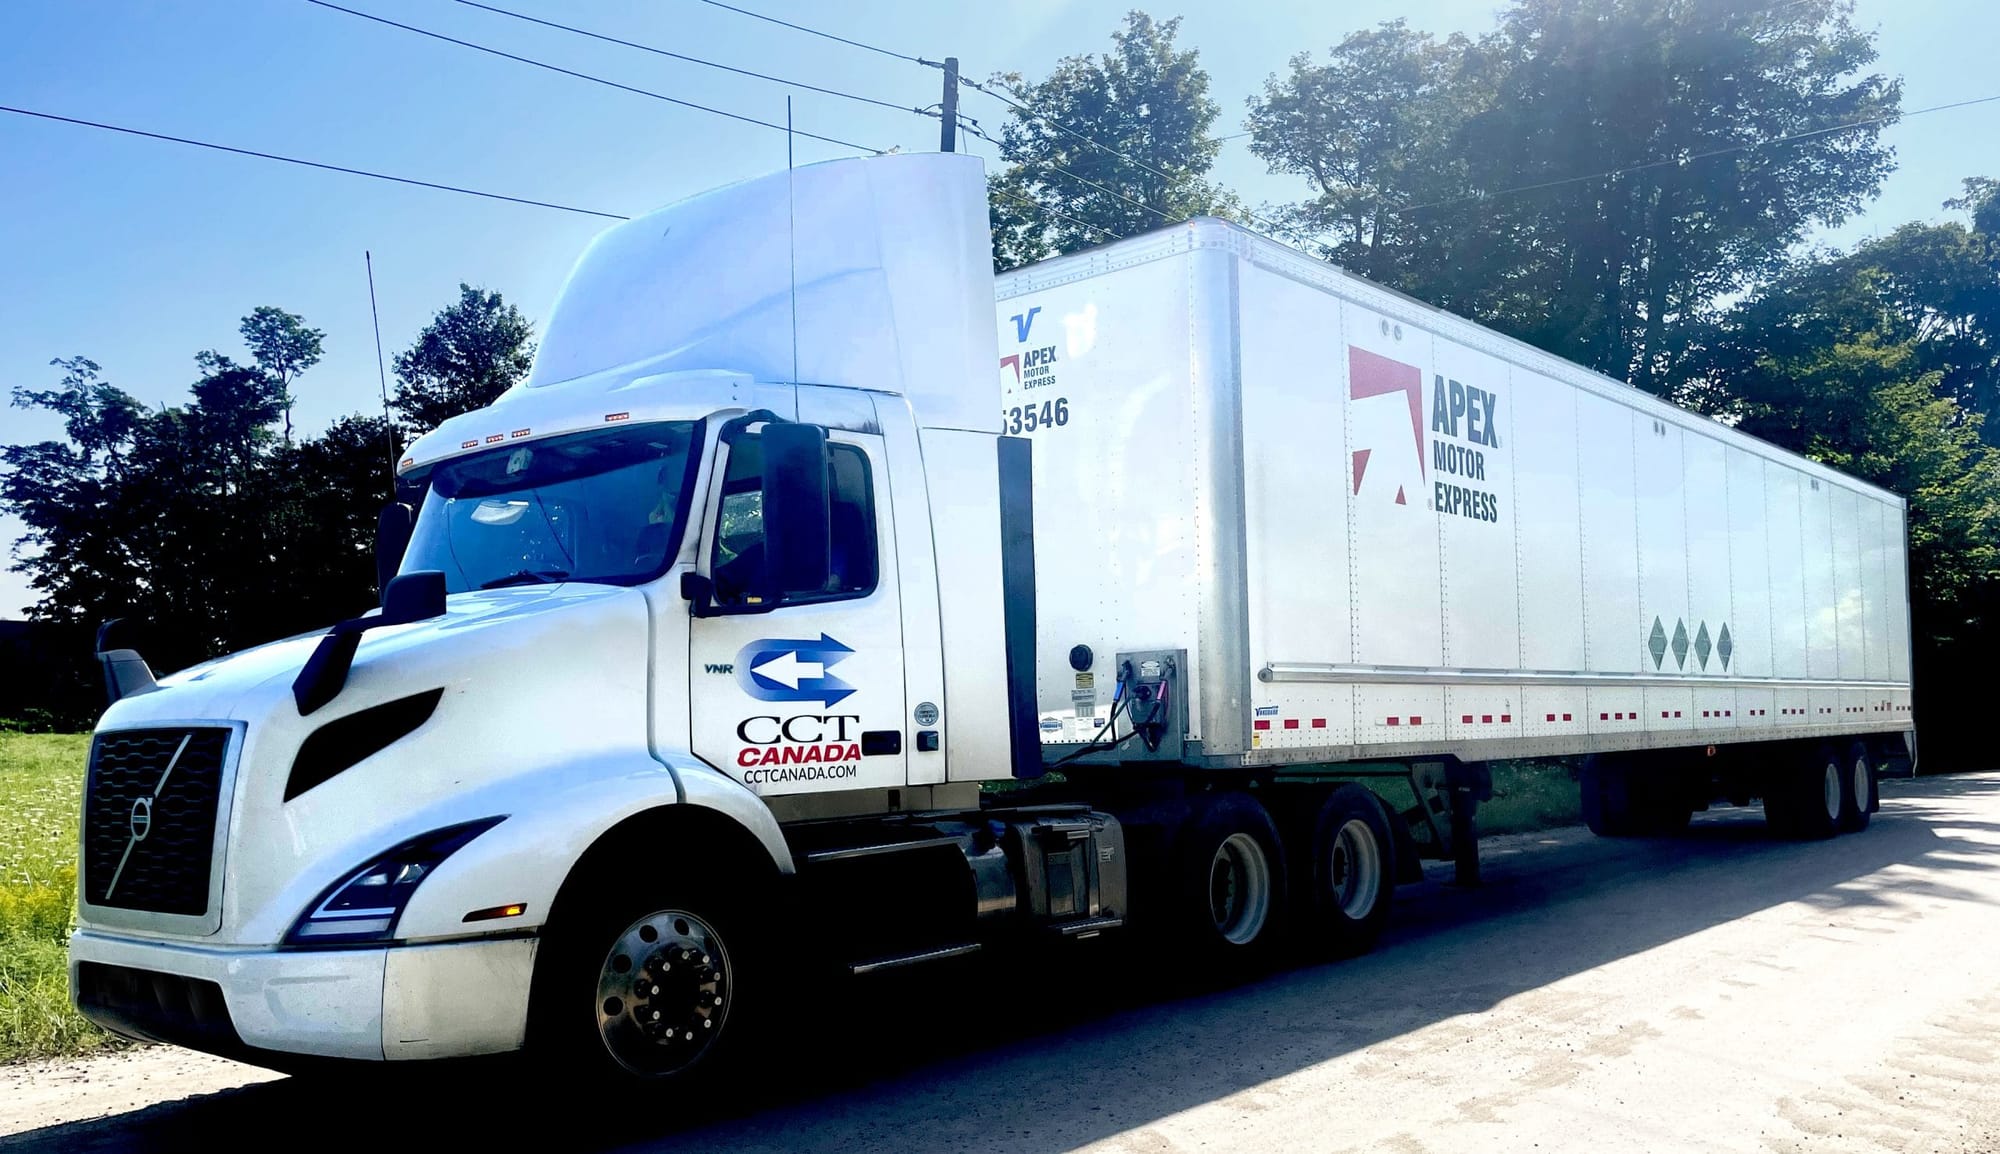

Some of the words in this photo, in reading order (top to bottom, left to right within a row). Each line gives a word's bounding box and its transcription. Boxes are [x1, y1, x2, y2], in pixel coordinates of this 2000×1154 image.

[1023, 345, 1057, 369] APEX
[1023, 365, 1050, 379] MOTOR
[1024, 375, 1056, 390] EXPRESS
[1432, 374, 1498, 449] APEX
[1433, 440, 1485, 481] MOTOR
[1434, 481, 1497, 523] EXPRESS
[704, 664, 734, 674] VNR
[736, 714, 860, 744] CCT
[737, 743, 861, 767] CANADA
[744, 764, 856, 784] CCTCANADA.COM
